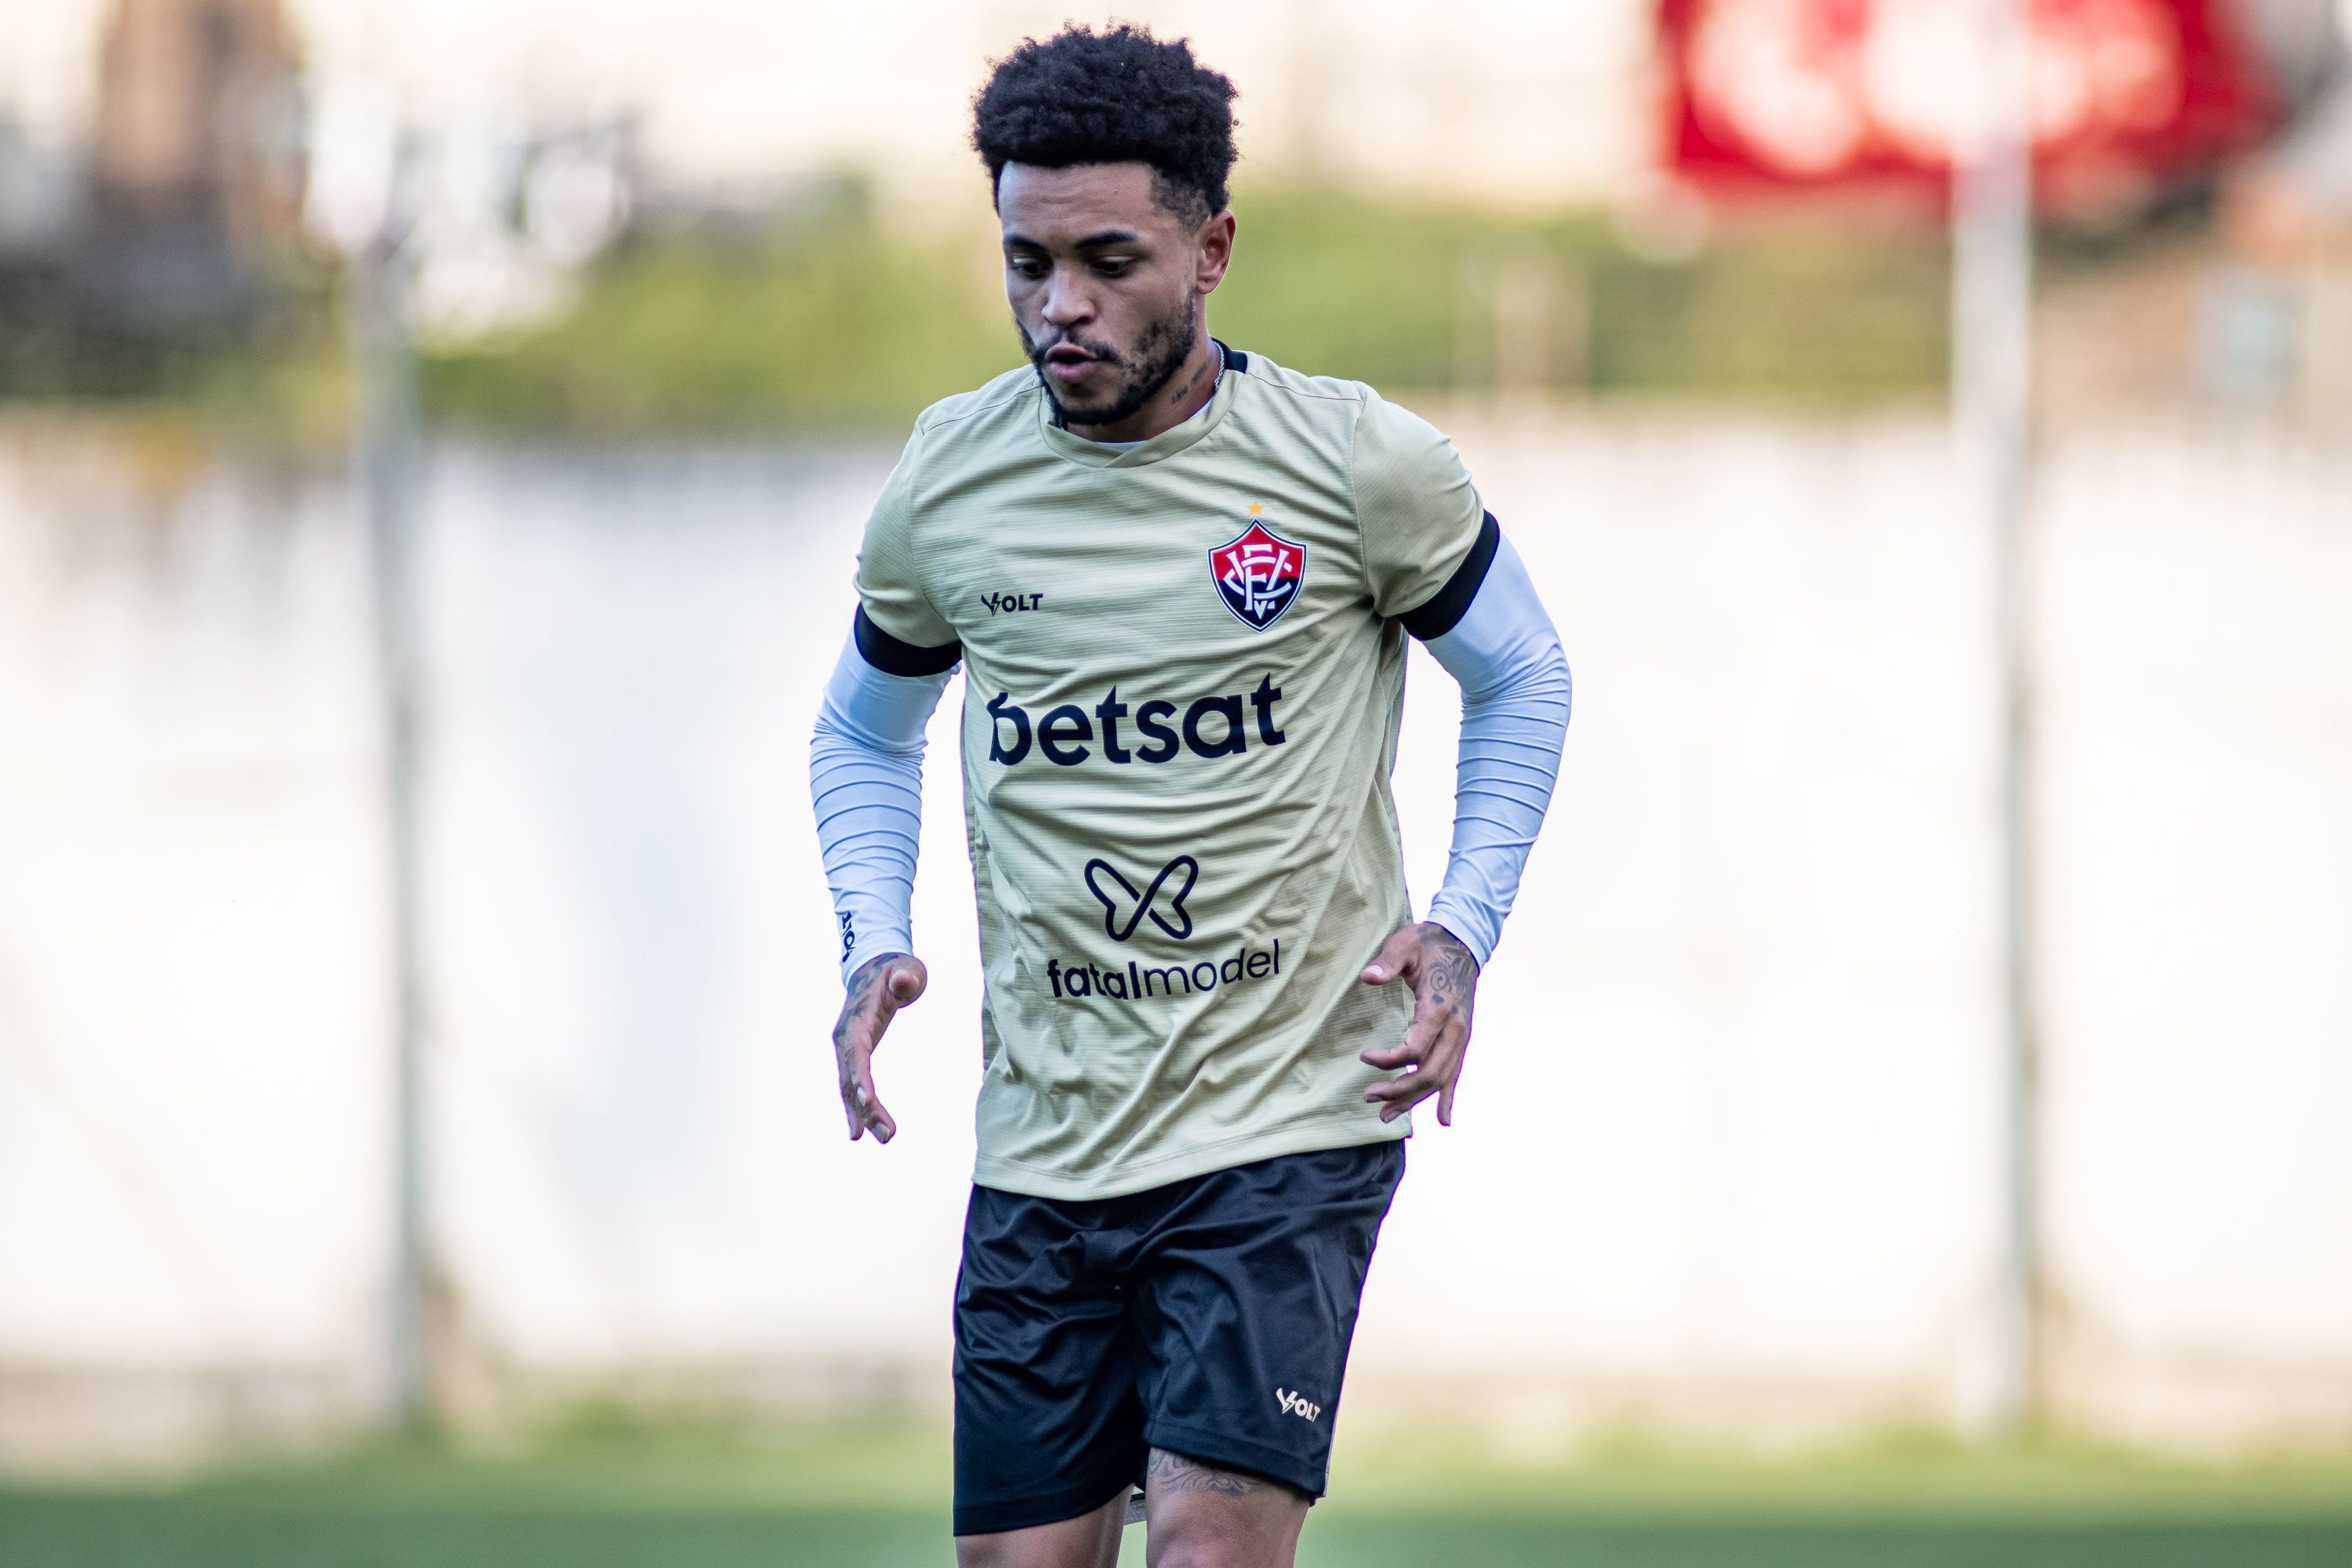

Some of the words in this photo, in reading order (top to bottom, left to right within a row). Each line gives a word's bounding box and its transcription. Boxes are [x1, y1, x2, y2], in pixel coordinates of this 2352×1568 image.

[980, 591, 1044, 617] VOLT
[986, 671, 1287, 767] betsat
[1047, 938, 1280, 1000] fatalmodel
[1276, 1387, 1321, 1423] VOLT
